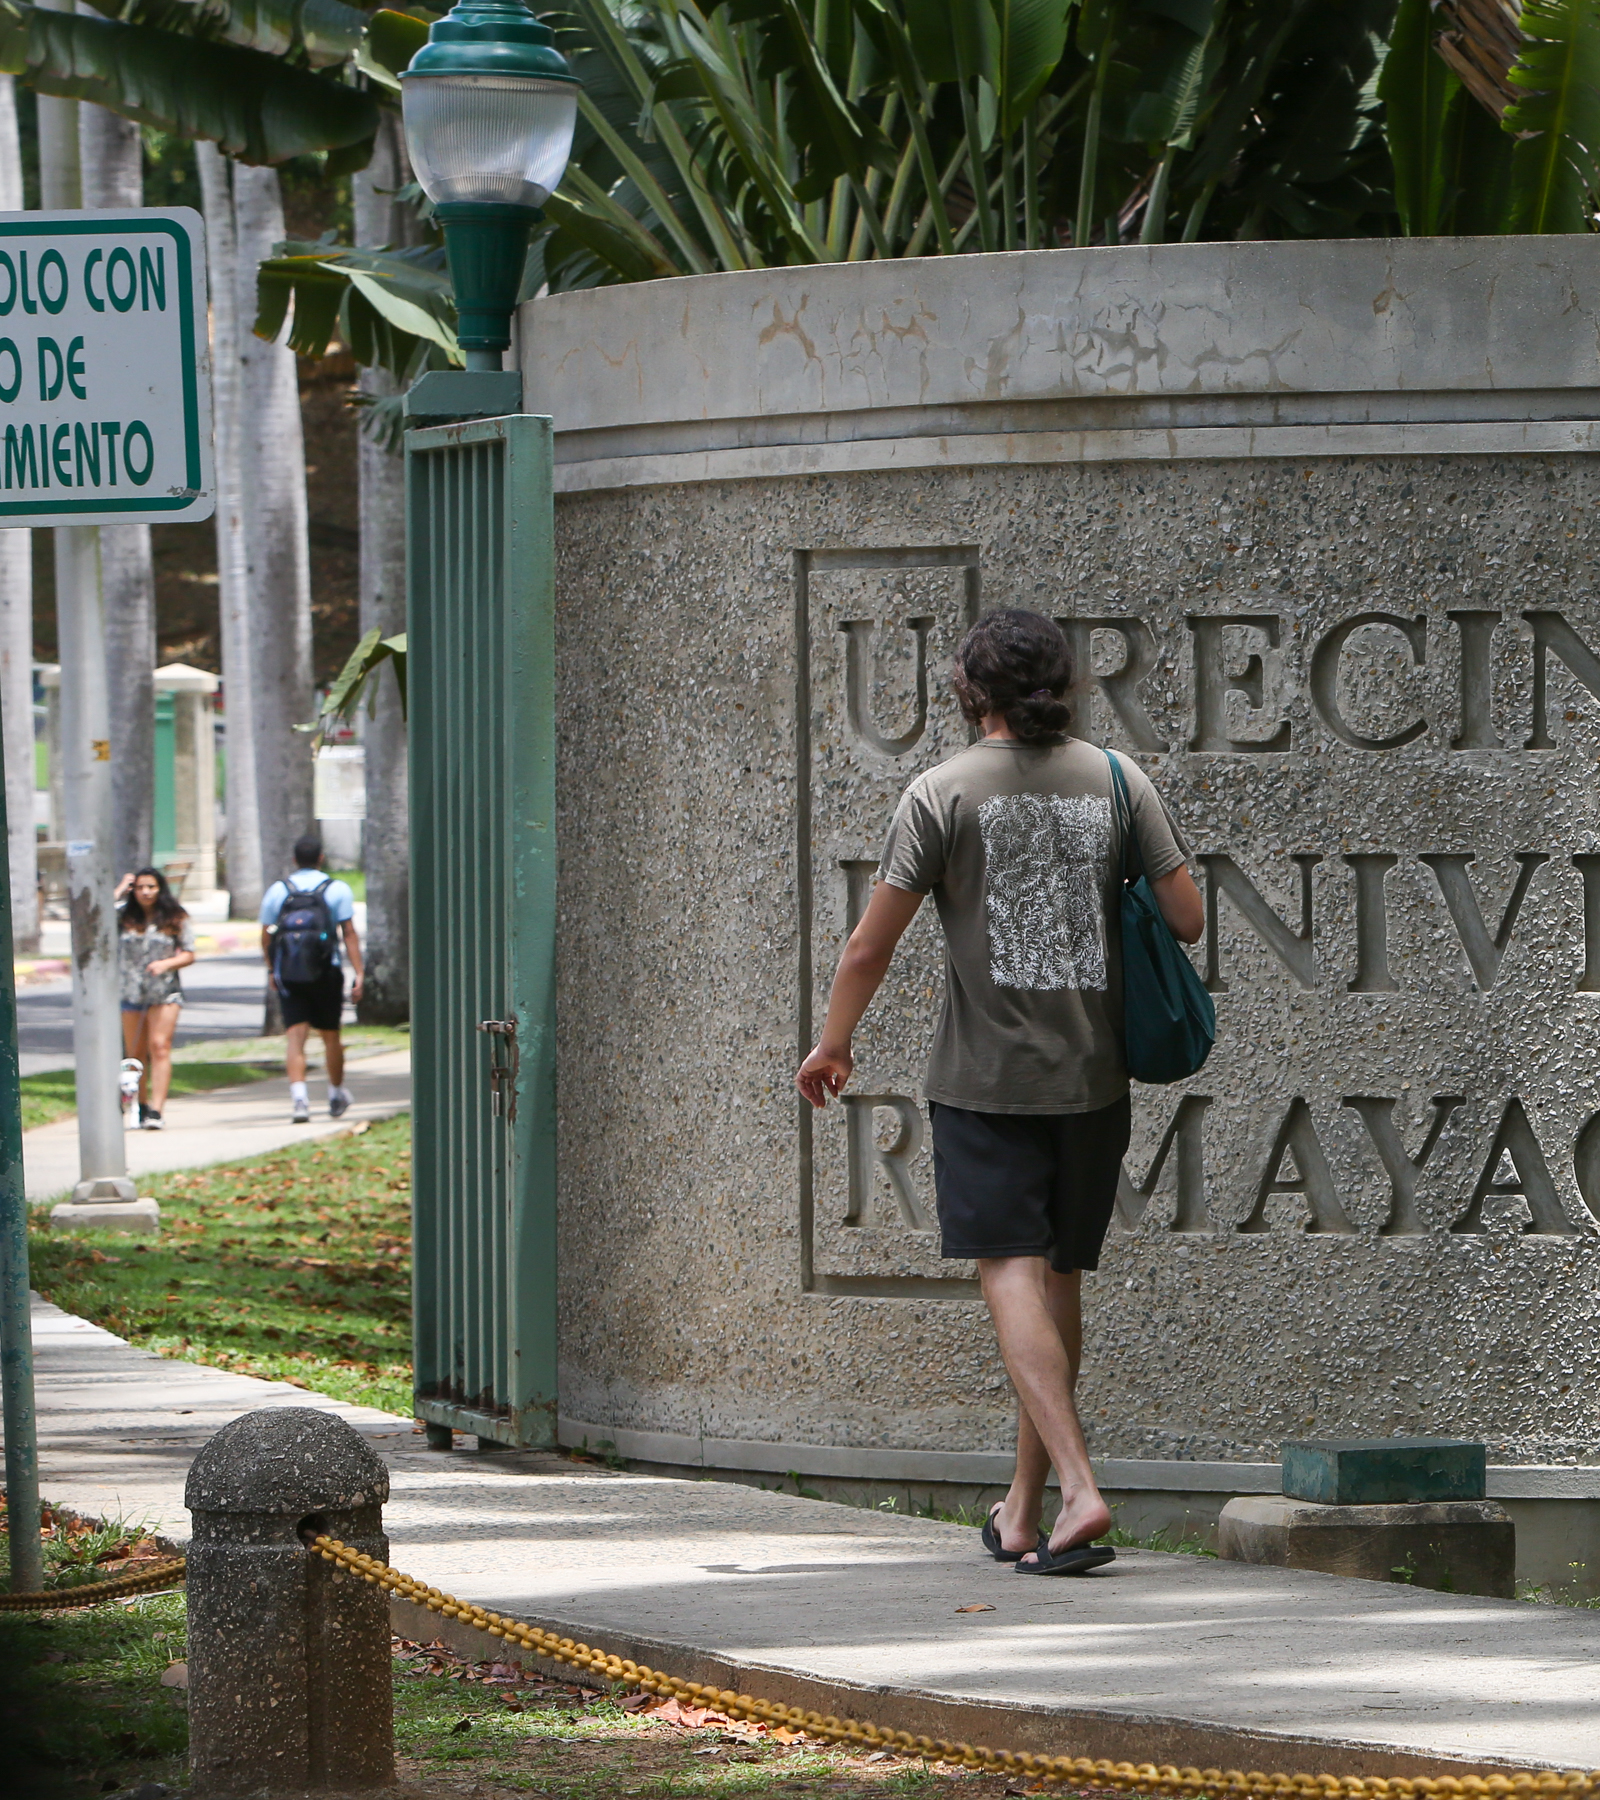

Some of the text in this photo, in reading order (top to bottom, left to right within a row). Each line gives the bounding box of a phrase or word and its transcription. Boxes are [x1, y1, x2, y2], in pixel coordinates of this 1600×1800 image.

[84, 246, 166, 313] CON
[37, 335, 87, 402] DE
[0, 420, 155, 490] MIENTO
[837, 614, 937, 757] U
[839, 1093, 941, 1232] R
